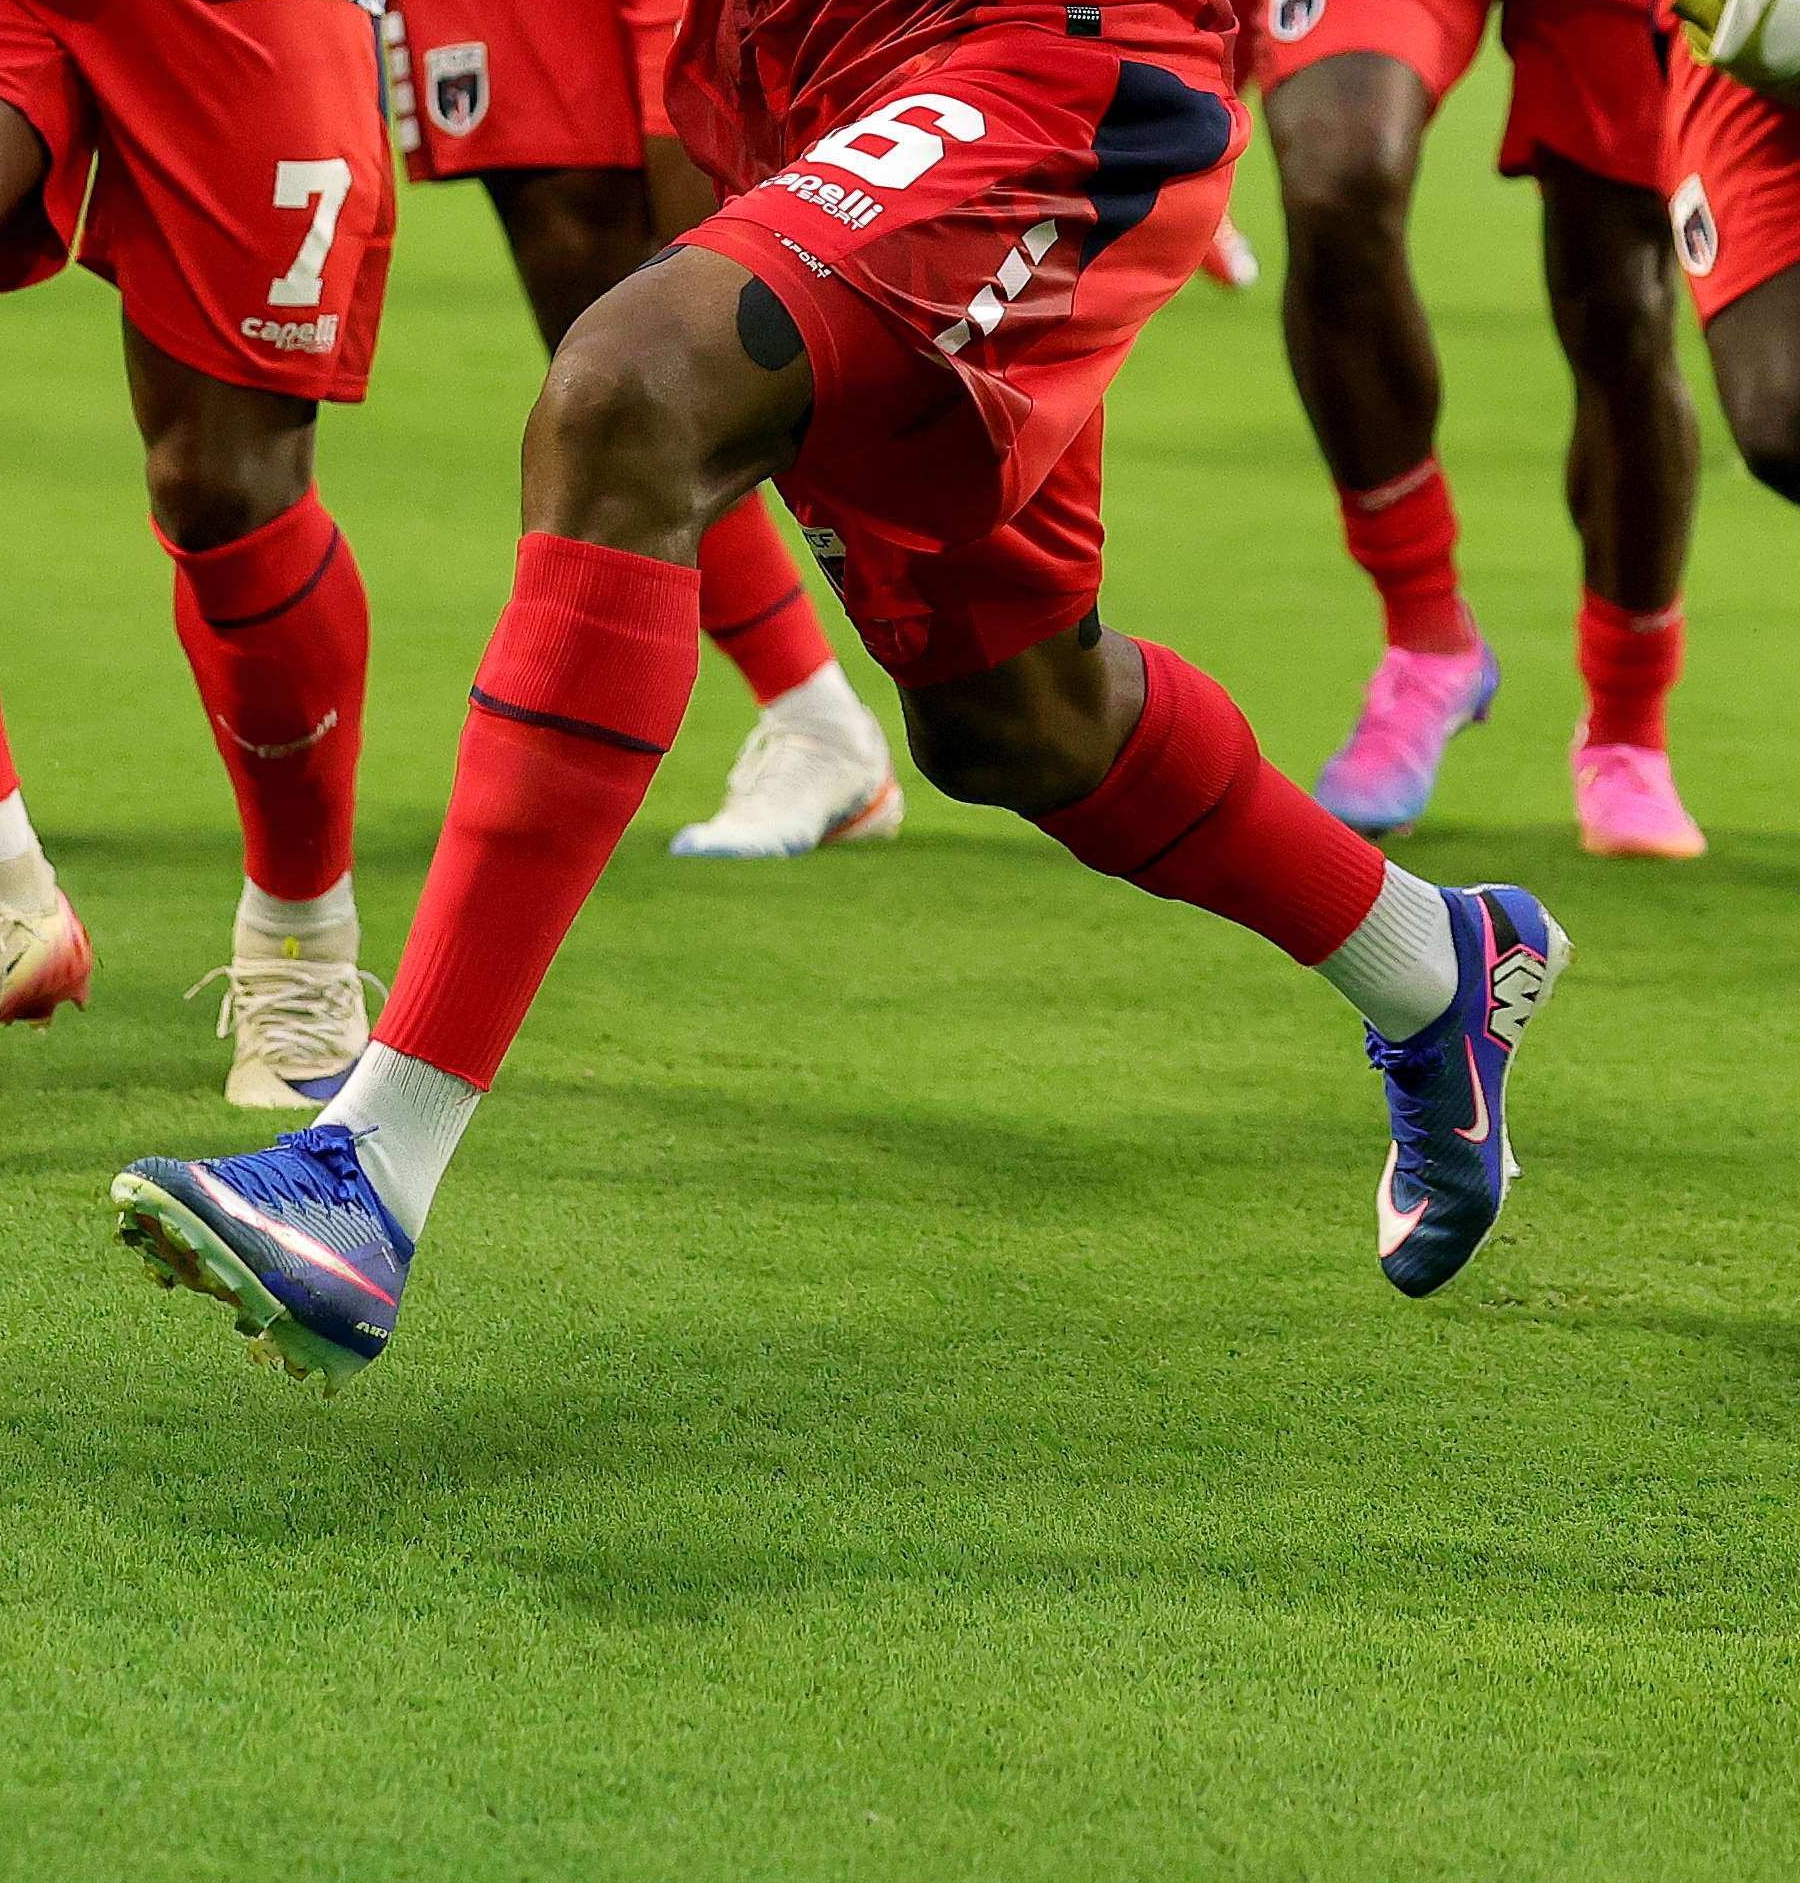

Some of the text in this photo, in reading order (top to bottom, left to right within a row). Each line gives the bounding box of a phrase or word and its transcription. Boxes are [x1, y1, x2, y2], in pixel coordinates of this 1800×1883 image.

[804, 92, 987, 190] 6
[267, 157, 354, 308] 7
[758, 172, 885, 230] capelli
[795, 189, 865, 231] SPORT
